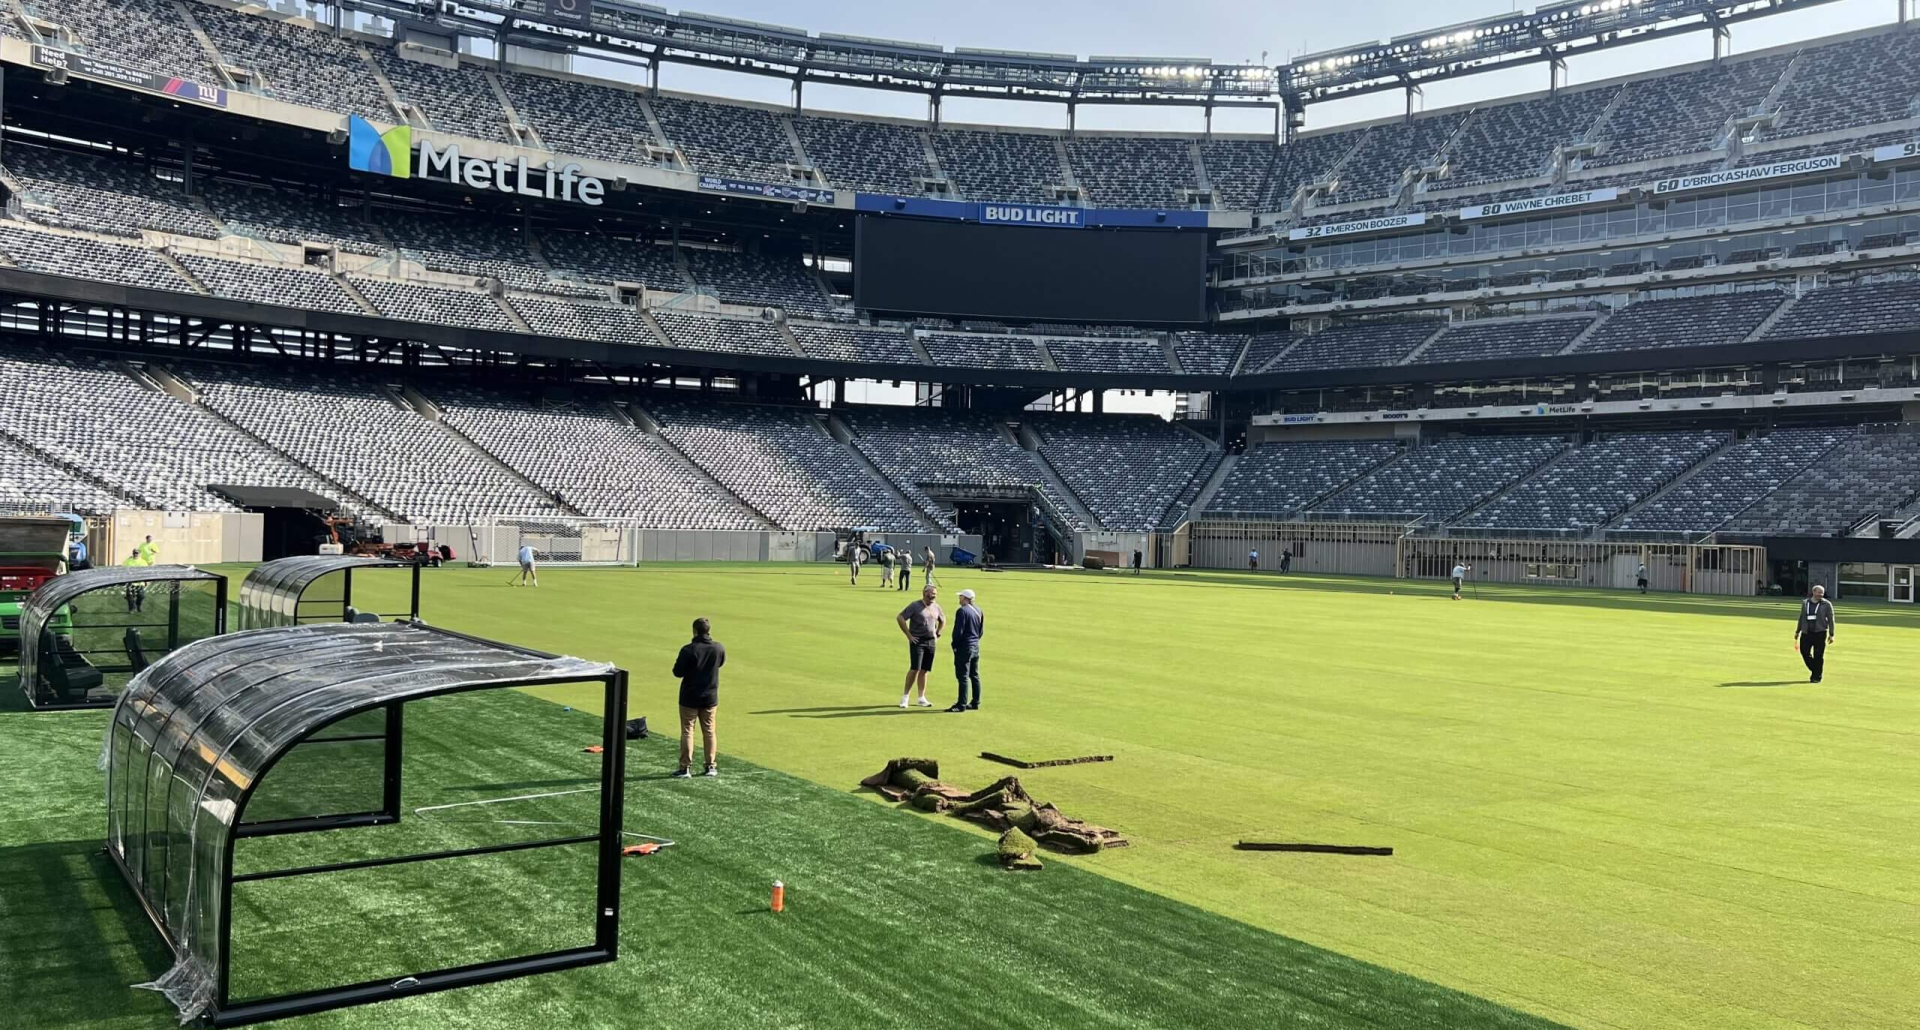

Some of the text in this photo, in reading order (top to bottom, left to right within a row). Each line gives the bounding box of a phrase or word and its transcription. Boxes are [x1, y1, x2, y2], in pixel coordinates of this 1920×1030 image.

[41, 47, 65, 59] Need
[41, 55, 68, 68] Help?
[198, 85, 217, 103] ny
[418, 139, 605, 206] MetLife
[1656, 156, 1838, 192] 60 D'BRICKASHAW FERGUSON
[699, 182, 727, 190] CHAMPIONS
[1482, 192, 1593, 216] 80 WAYNE CHREBET
[985, 206, 1078, 224] BUD LIGHT
[1305, 216, 1408, 238] 32 EMERSON BOOZER
[1549, 406, 1576, 414] MetLife
